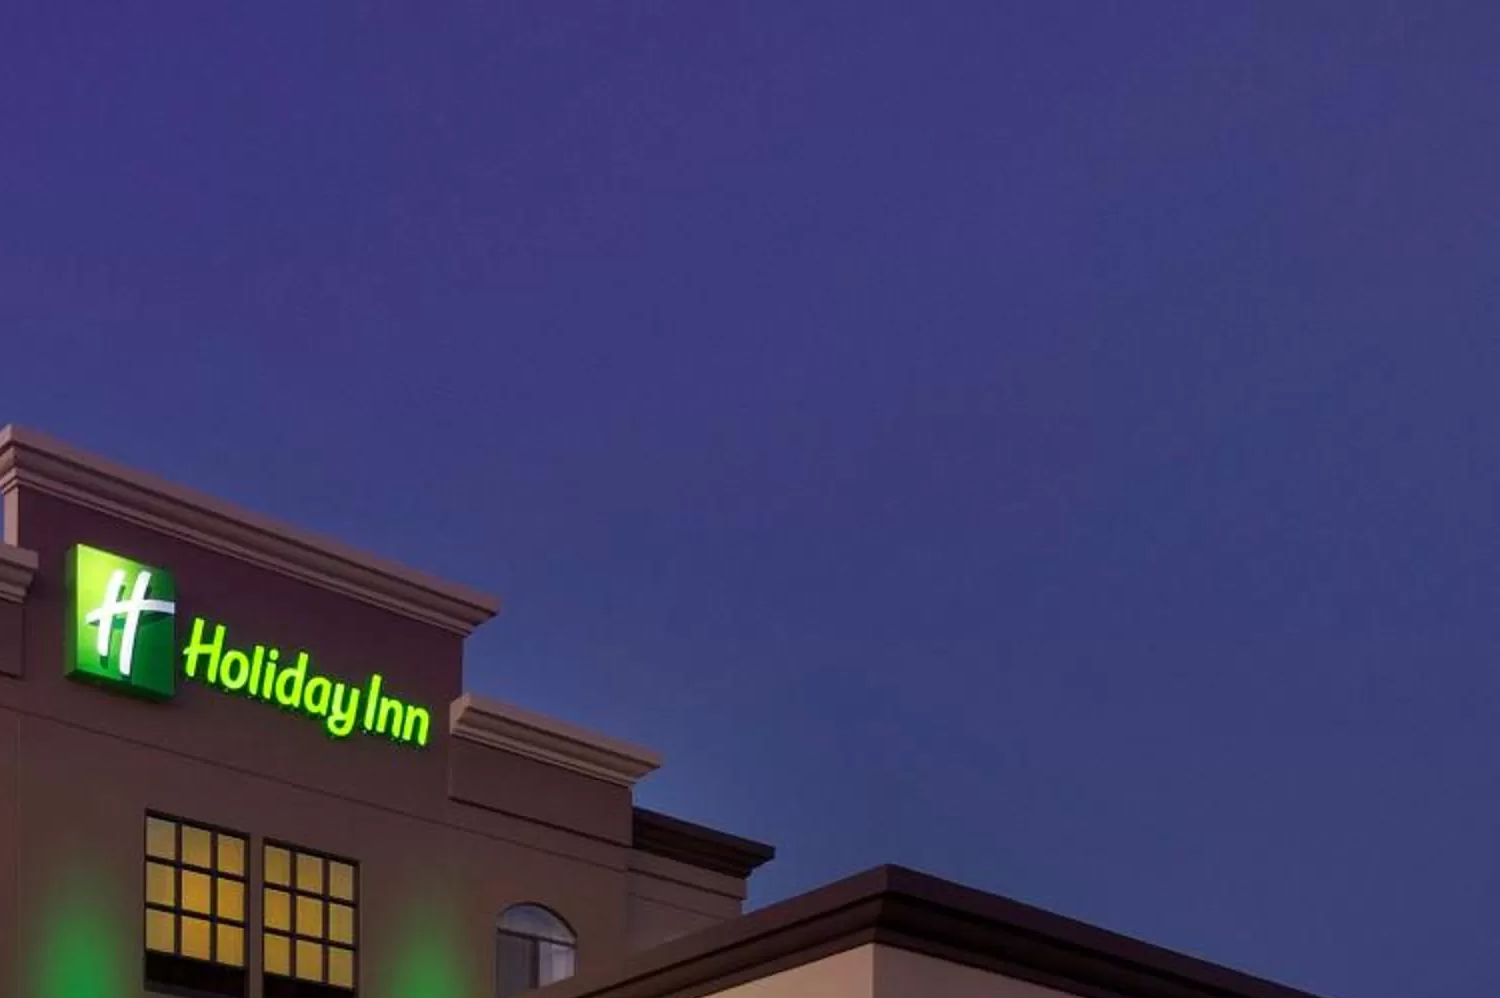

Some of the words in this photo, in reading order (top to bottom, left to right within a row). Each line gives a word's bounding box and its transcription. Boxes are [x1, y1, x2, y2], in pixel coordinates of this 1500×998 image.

[85, 568, 175, 676] H
[183, 618, 361, 736] Holiday
[364, 673, 430, 747] Inn
